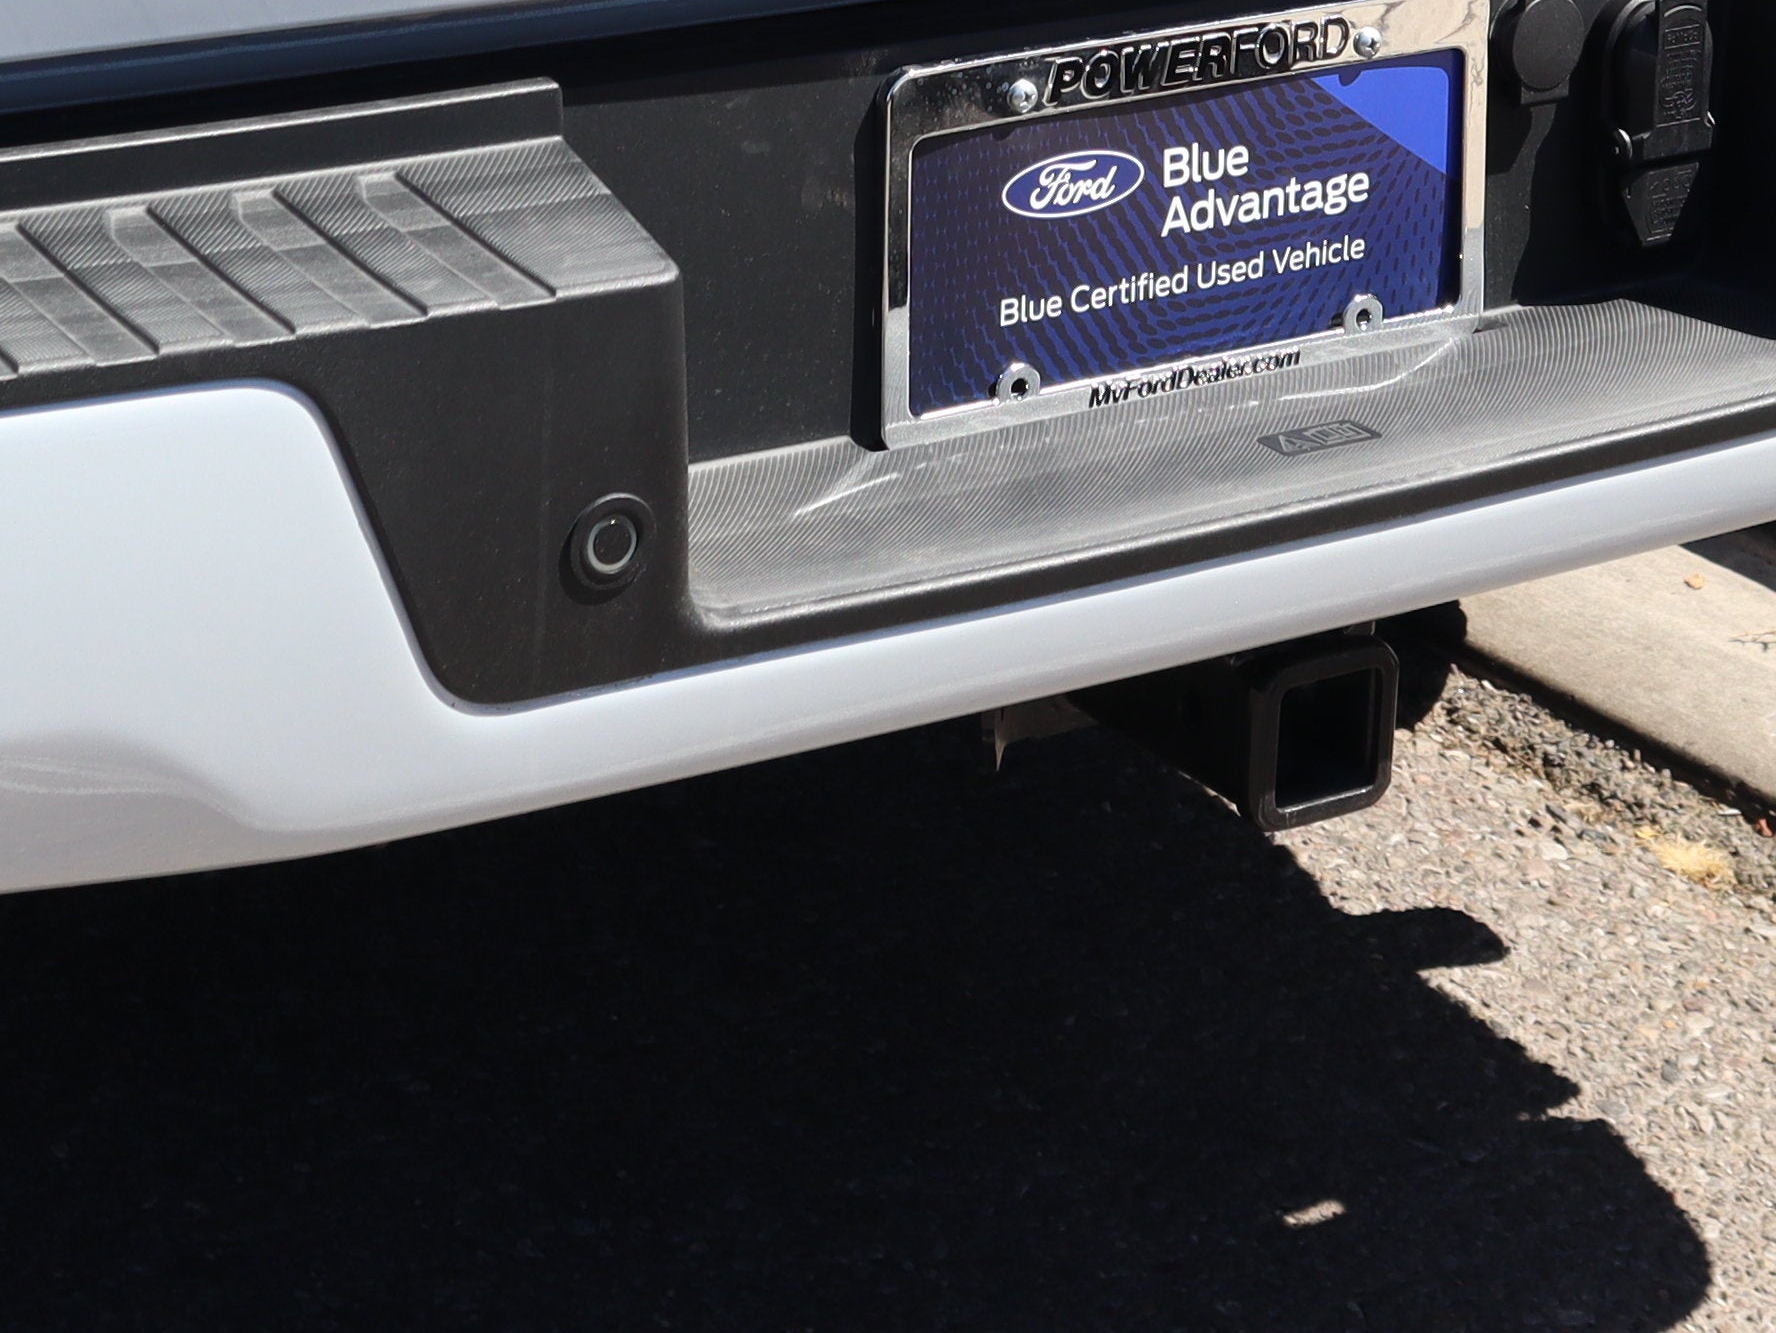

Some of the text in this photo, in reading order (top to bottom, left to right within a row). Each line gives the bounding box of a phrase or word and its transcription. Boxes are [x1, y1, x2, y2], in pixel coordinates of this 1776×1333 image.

[1043, 16, 1351, 107] POWERFORD
[1029, 161, 1120, 212] Ford
[1162, 143, 1250, 188] Blue
[1161, 169, 1371, 237] Advantage
[999, 234, 1366, 328] Blue Certified Used Vehicle
